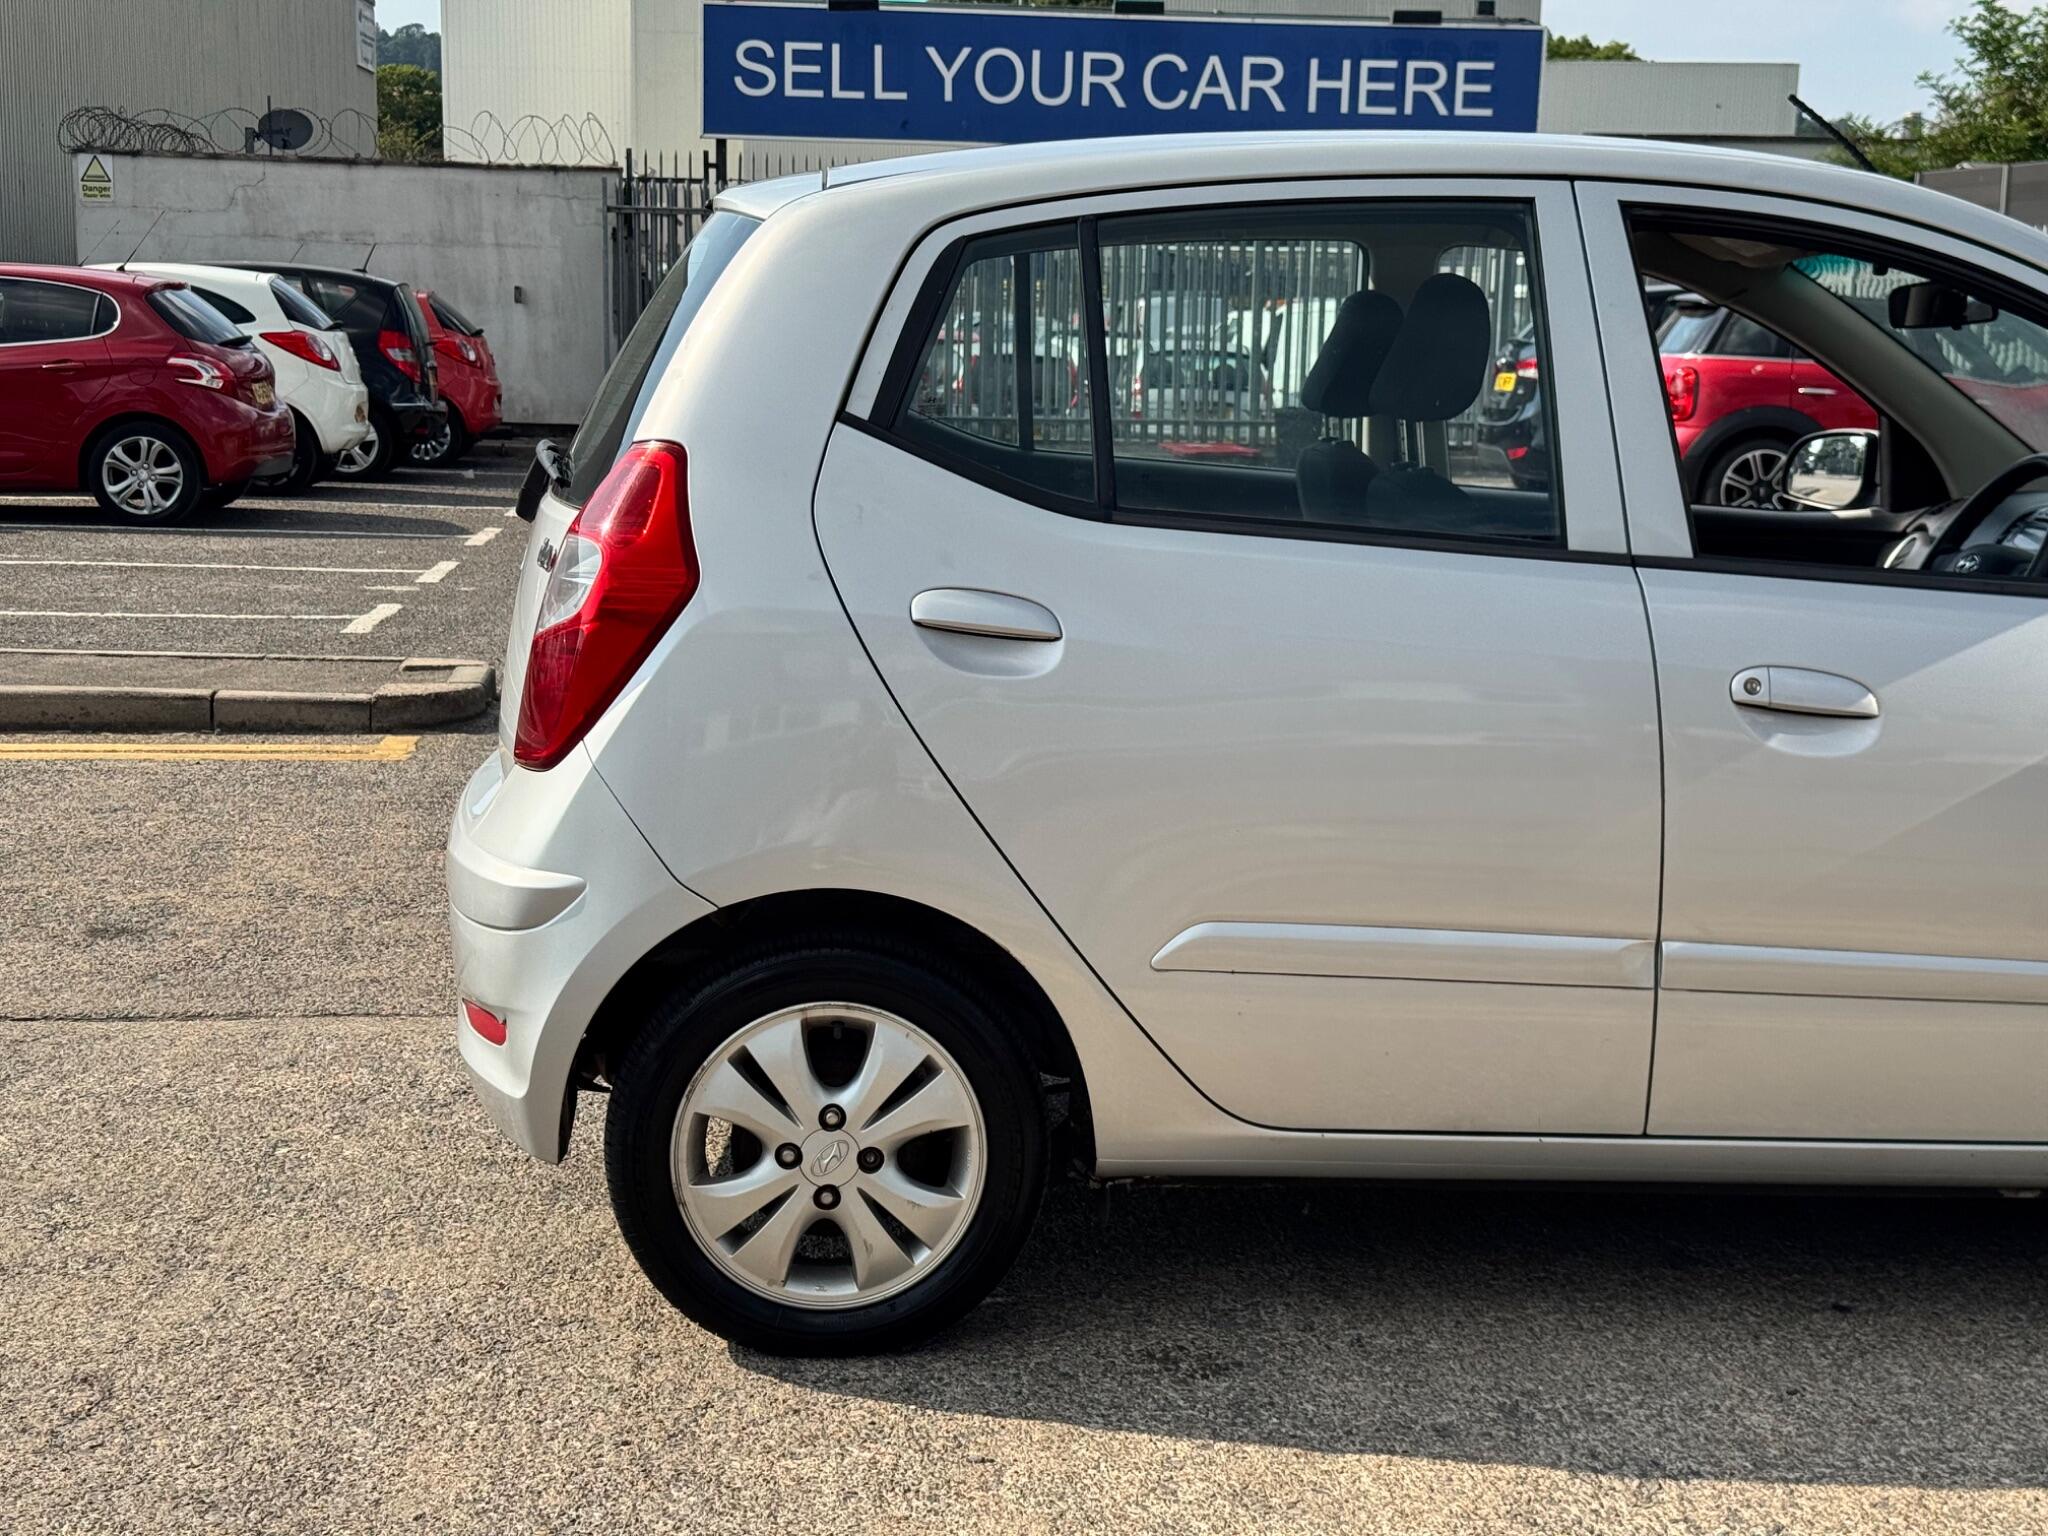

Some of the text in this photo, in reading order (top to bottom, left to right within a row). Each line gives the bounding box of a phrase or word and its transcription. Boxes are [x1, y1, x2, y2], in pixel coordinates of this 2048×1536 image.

[734, 39, 908, 100] SELL
[925, 46, 1126, 108] YOUR
[1142, 53, 1286, 112] CAR
[1307, 57, 1495, 117] HERE
[82, 184, 111, 193] Danger
